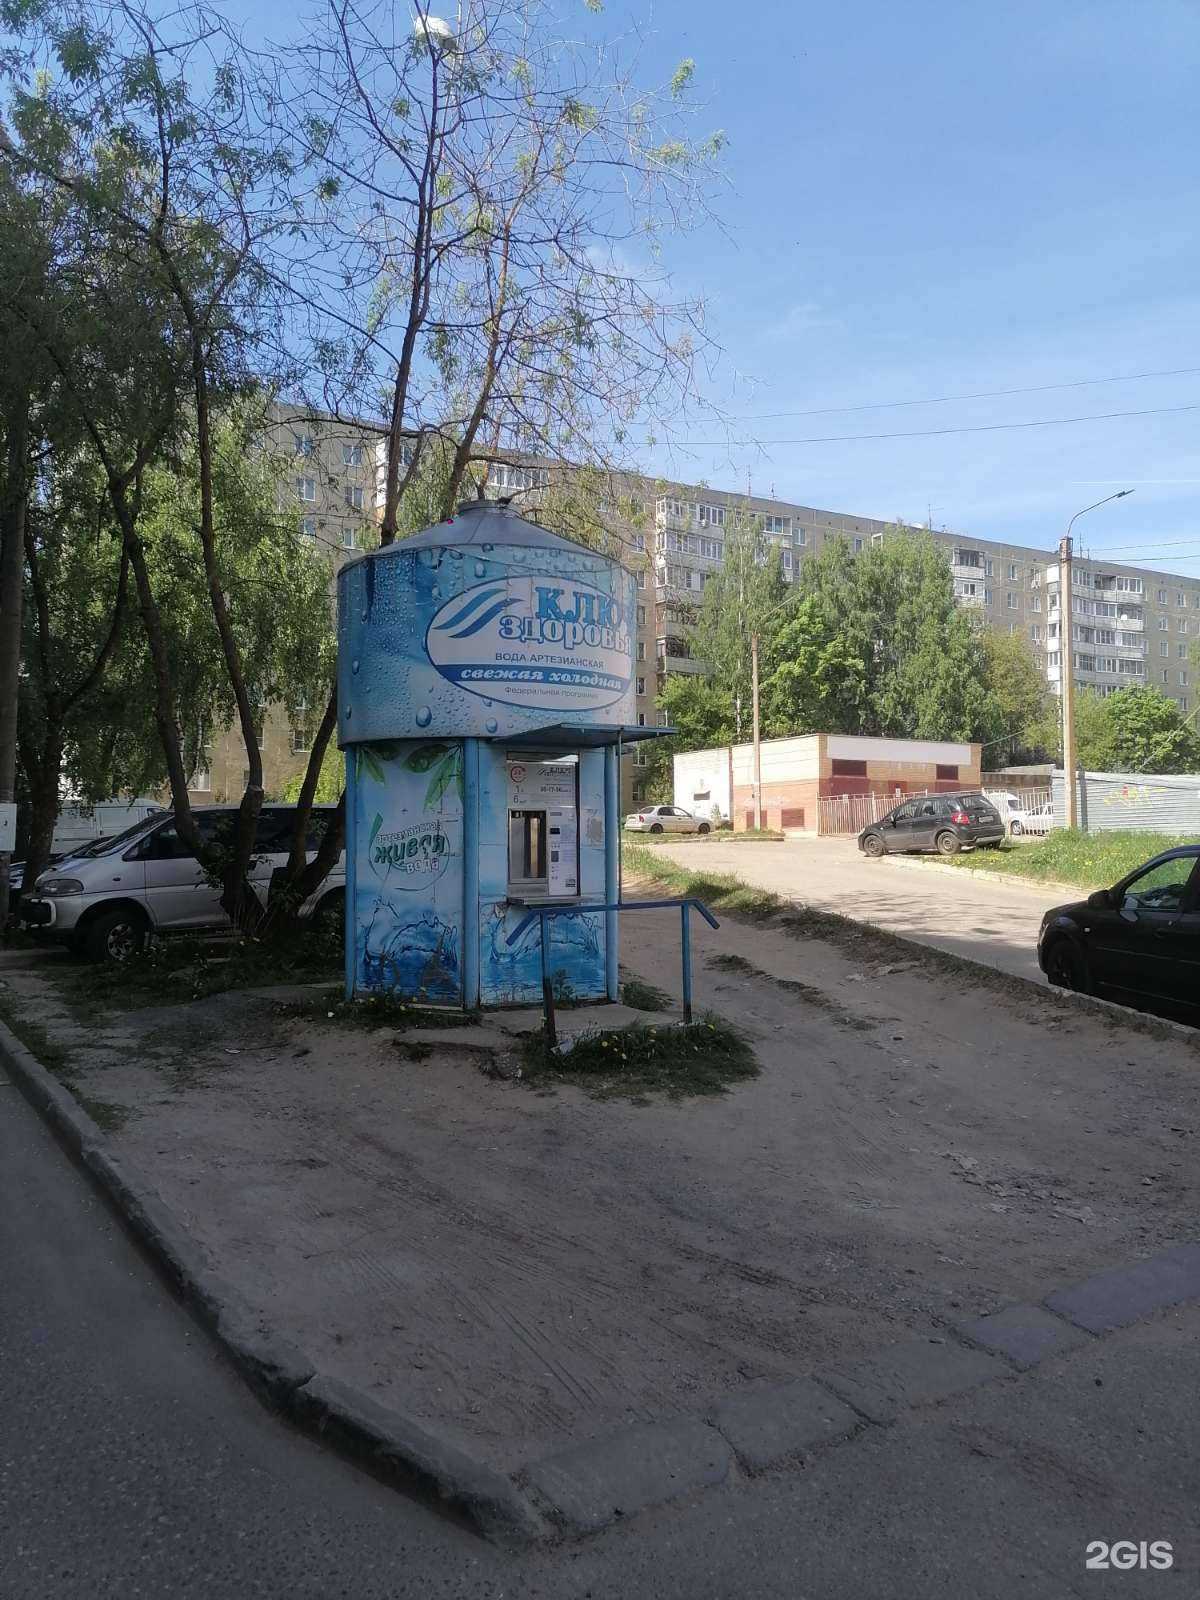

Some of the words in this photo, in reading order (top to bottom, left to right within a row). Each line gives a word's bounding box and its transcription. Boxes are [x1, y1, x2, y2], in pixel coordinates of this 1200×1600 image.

[495, 652, 527, 662] ВОДА
[530, 654, 604, 669] АРТЕЗИАНСКАЯ
[461, 668, 544, 681] свежая
[549, 672, 622, 690] холодная
